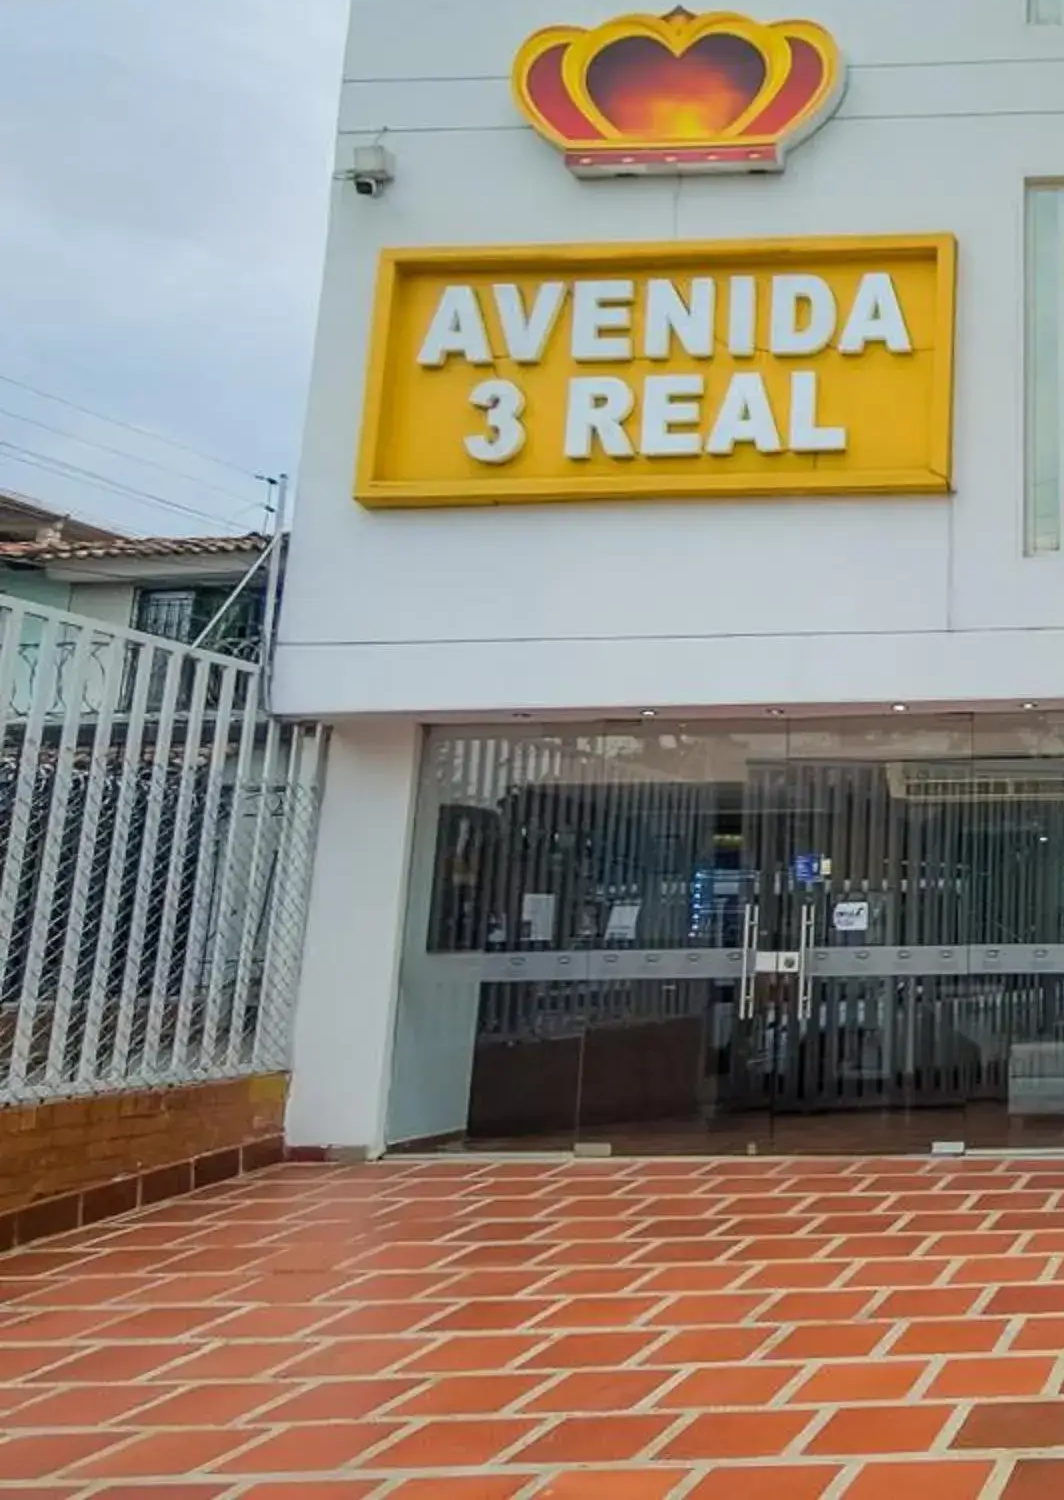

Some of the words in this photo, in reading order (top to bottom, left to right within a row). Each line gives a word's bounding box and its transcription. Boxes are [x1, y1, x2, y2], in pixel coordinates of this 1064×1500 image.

[415, 272, 913, 367] AVENIDA
[462, 378, 526, 464] 3
[564, 371, 847, 460] REAL
